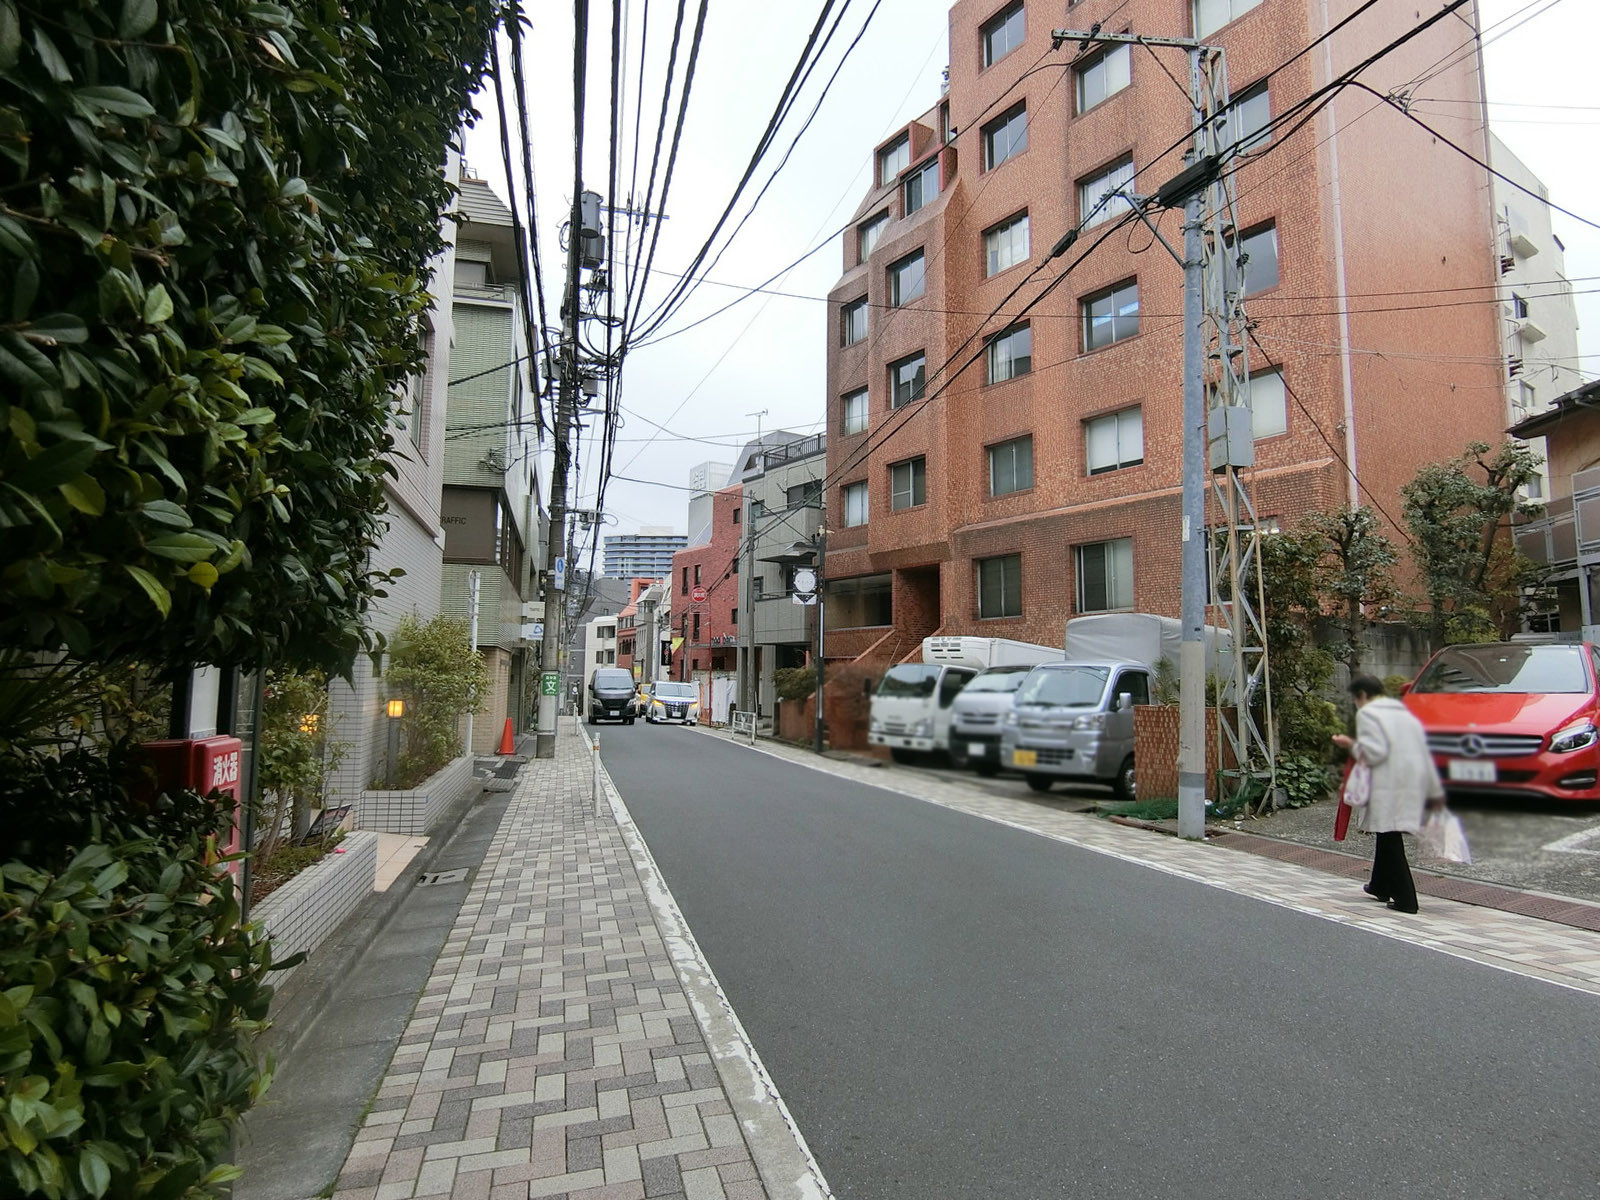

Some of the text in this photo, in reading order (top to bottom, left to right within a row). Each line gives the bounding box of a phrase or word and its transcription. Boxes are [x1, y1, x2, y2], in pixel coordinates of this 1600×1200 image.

[440, 516, 467, 525] RAFFIC
[545, 680, 556, 692] 文
[213, 751, 238, 786] 消火器
